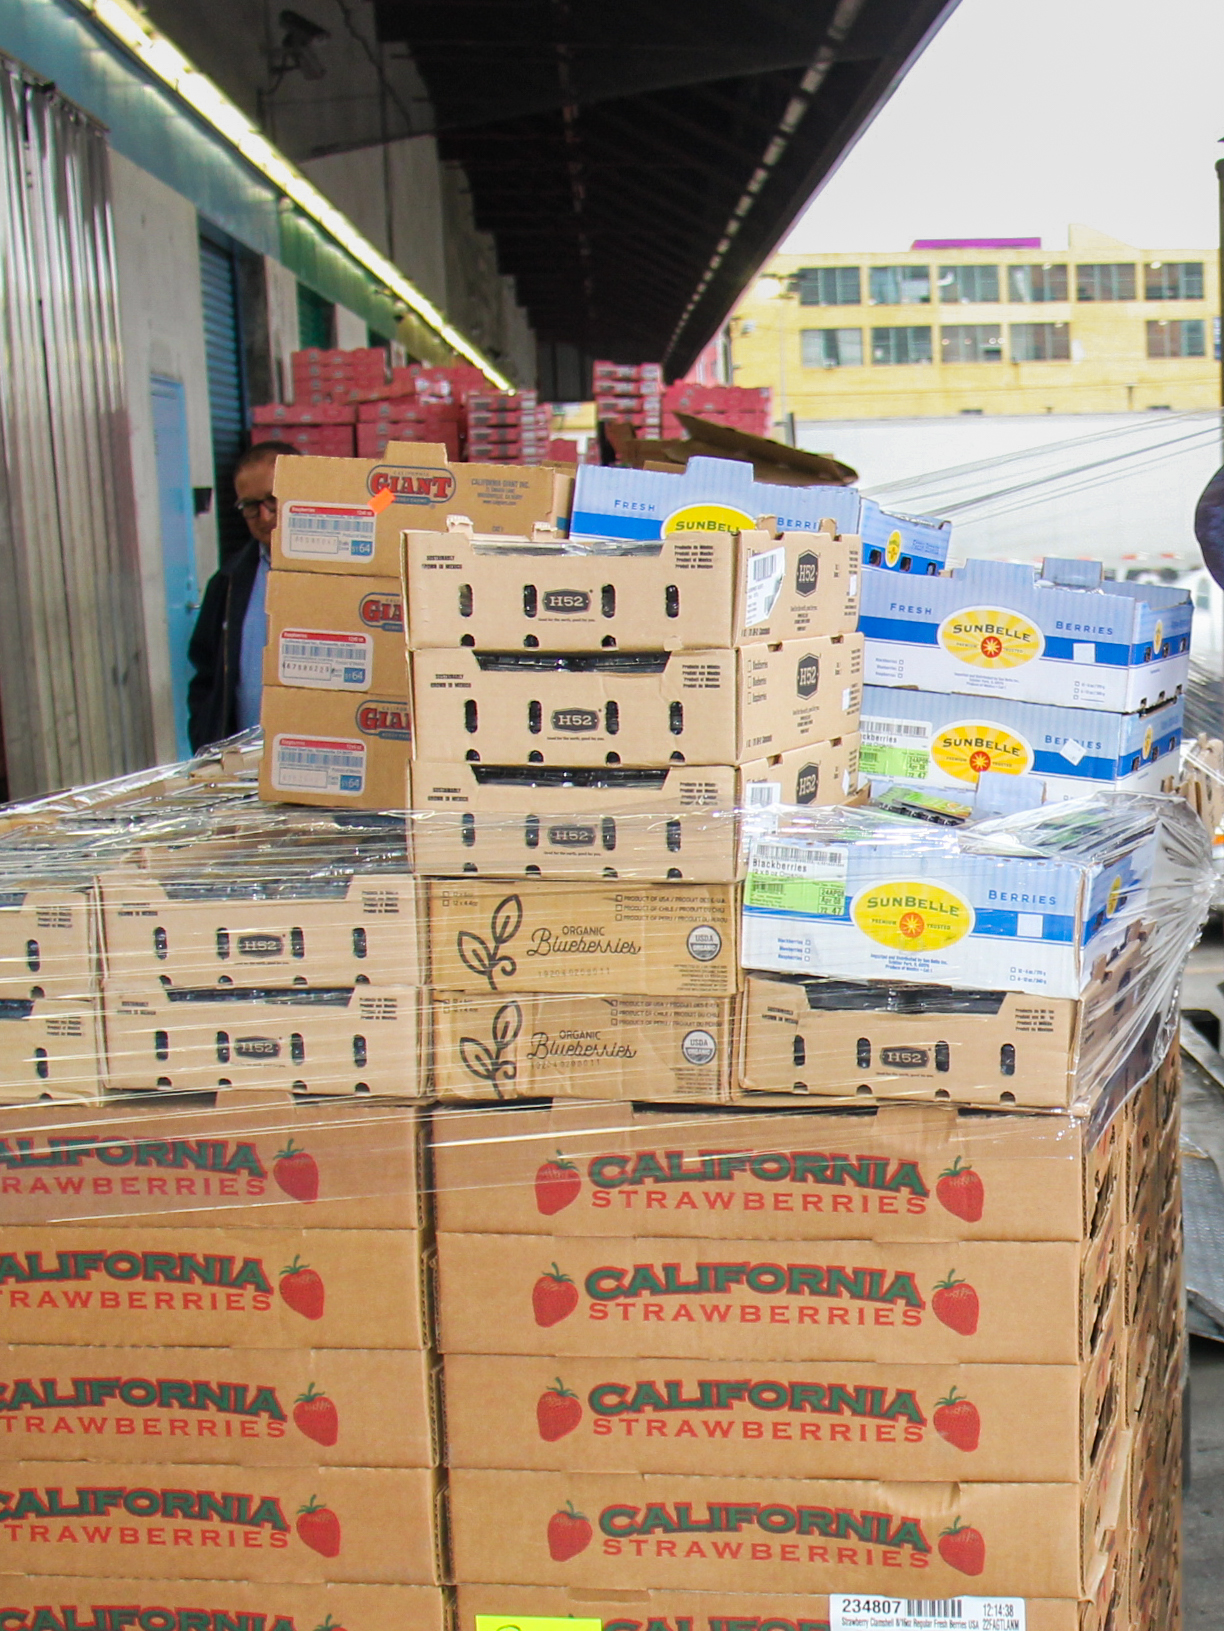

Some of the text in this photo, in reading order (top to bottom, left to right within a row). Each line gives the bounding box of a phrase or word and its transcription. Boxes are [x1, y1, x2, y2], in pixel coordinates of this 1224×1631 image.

[370, 472, 452, 499] GIANT
[614, 499, 656, 512] FRESH
[675, 517, 820, 536] SUNBELL BERRI
[798, 564, 816, 584] H52
[361, 599, 404, 623] GIA
[549, 595, 585, 607] H52
[889, 602, 933, 615] FRESH
[952, 623, 1031, 643] SUNBELLE
[1055, 620, 1113, 636] BERRIES
[799, 666, 817, 686] H52
[358, 707, 412, 731] GIA
[557, 714, 593, 726] H52
[862, 733, 897, 744] ckberries
[942, 737, 1021, 757] SUNBELLE
[799, 775, 817, 795] H52
[554, 830, 589, 841] H52
[752, 858, 807, 873] Blackberries
[866, 895, 960, 918] SUNBELLE
[988, 889, 1057, 906] BERRIES
[831, 907, 842, 915] 47
[561, 925, 606, 936] ORGANIC
[871, 918, 897, 926] PREMIUM
[926, 923, 951, 931] TRUSTED
[244, 940, 277, 950] H52
[526, 927, 642, 957] Blueberries
[695, 934, 714, 942] USDA
[559, 1029, 601, 1041] ORGANIC
[690, 1039, 709, 1047] USDA
[241, 1043, 274, 1053] H52
[526, 1031, 638, 1060] Blueberries
[886, 1051, 922, 1063] H52
[0, 1135, 268, 1180] ALIFORNIA
[587, 1150, 930, 1198] CALIFORNIA
[0, 1176, 266, 1197] RAWBERRIES
[591, 1189, 927, 1215] STRAWBERRIES
[0, 1249, 274, 1295] ALIFORNIA
[585, 1261, 926, 1310] CALIFORNIA
[0, 1290, 272, 1312] RAWBERRIES
[588, 1301, 923, 1327] STRAWBERRIES
[0, 1376, 288, 1423] ALIFORNIA
[587, 1378, 927, 1428] CALIFORNIA
[0, 1415, 286, 1438] TRAWBERRIES
[592, 1417, 924, 1443] STRAWBERRIES
[3, 1523, 288, 1549] TRAWBERRIES
[598, 1501, 931, 1553] CALIFORNIA
[602, 1538, 929, 1569] STRAWBERRIES
[842, 1598, 1015, 1619] 234807 12:14:38
[841, 1617, 870, 1628] Strawberry
[870, 1618, 894, 1628] Clamshell
[913, 1619, 932, 1629] Regular
[934, 1619, 948, 1629] Fresh
[949, 1619, 967, 1629] Berries
[968, 1619, 979, 1629] USA
